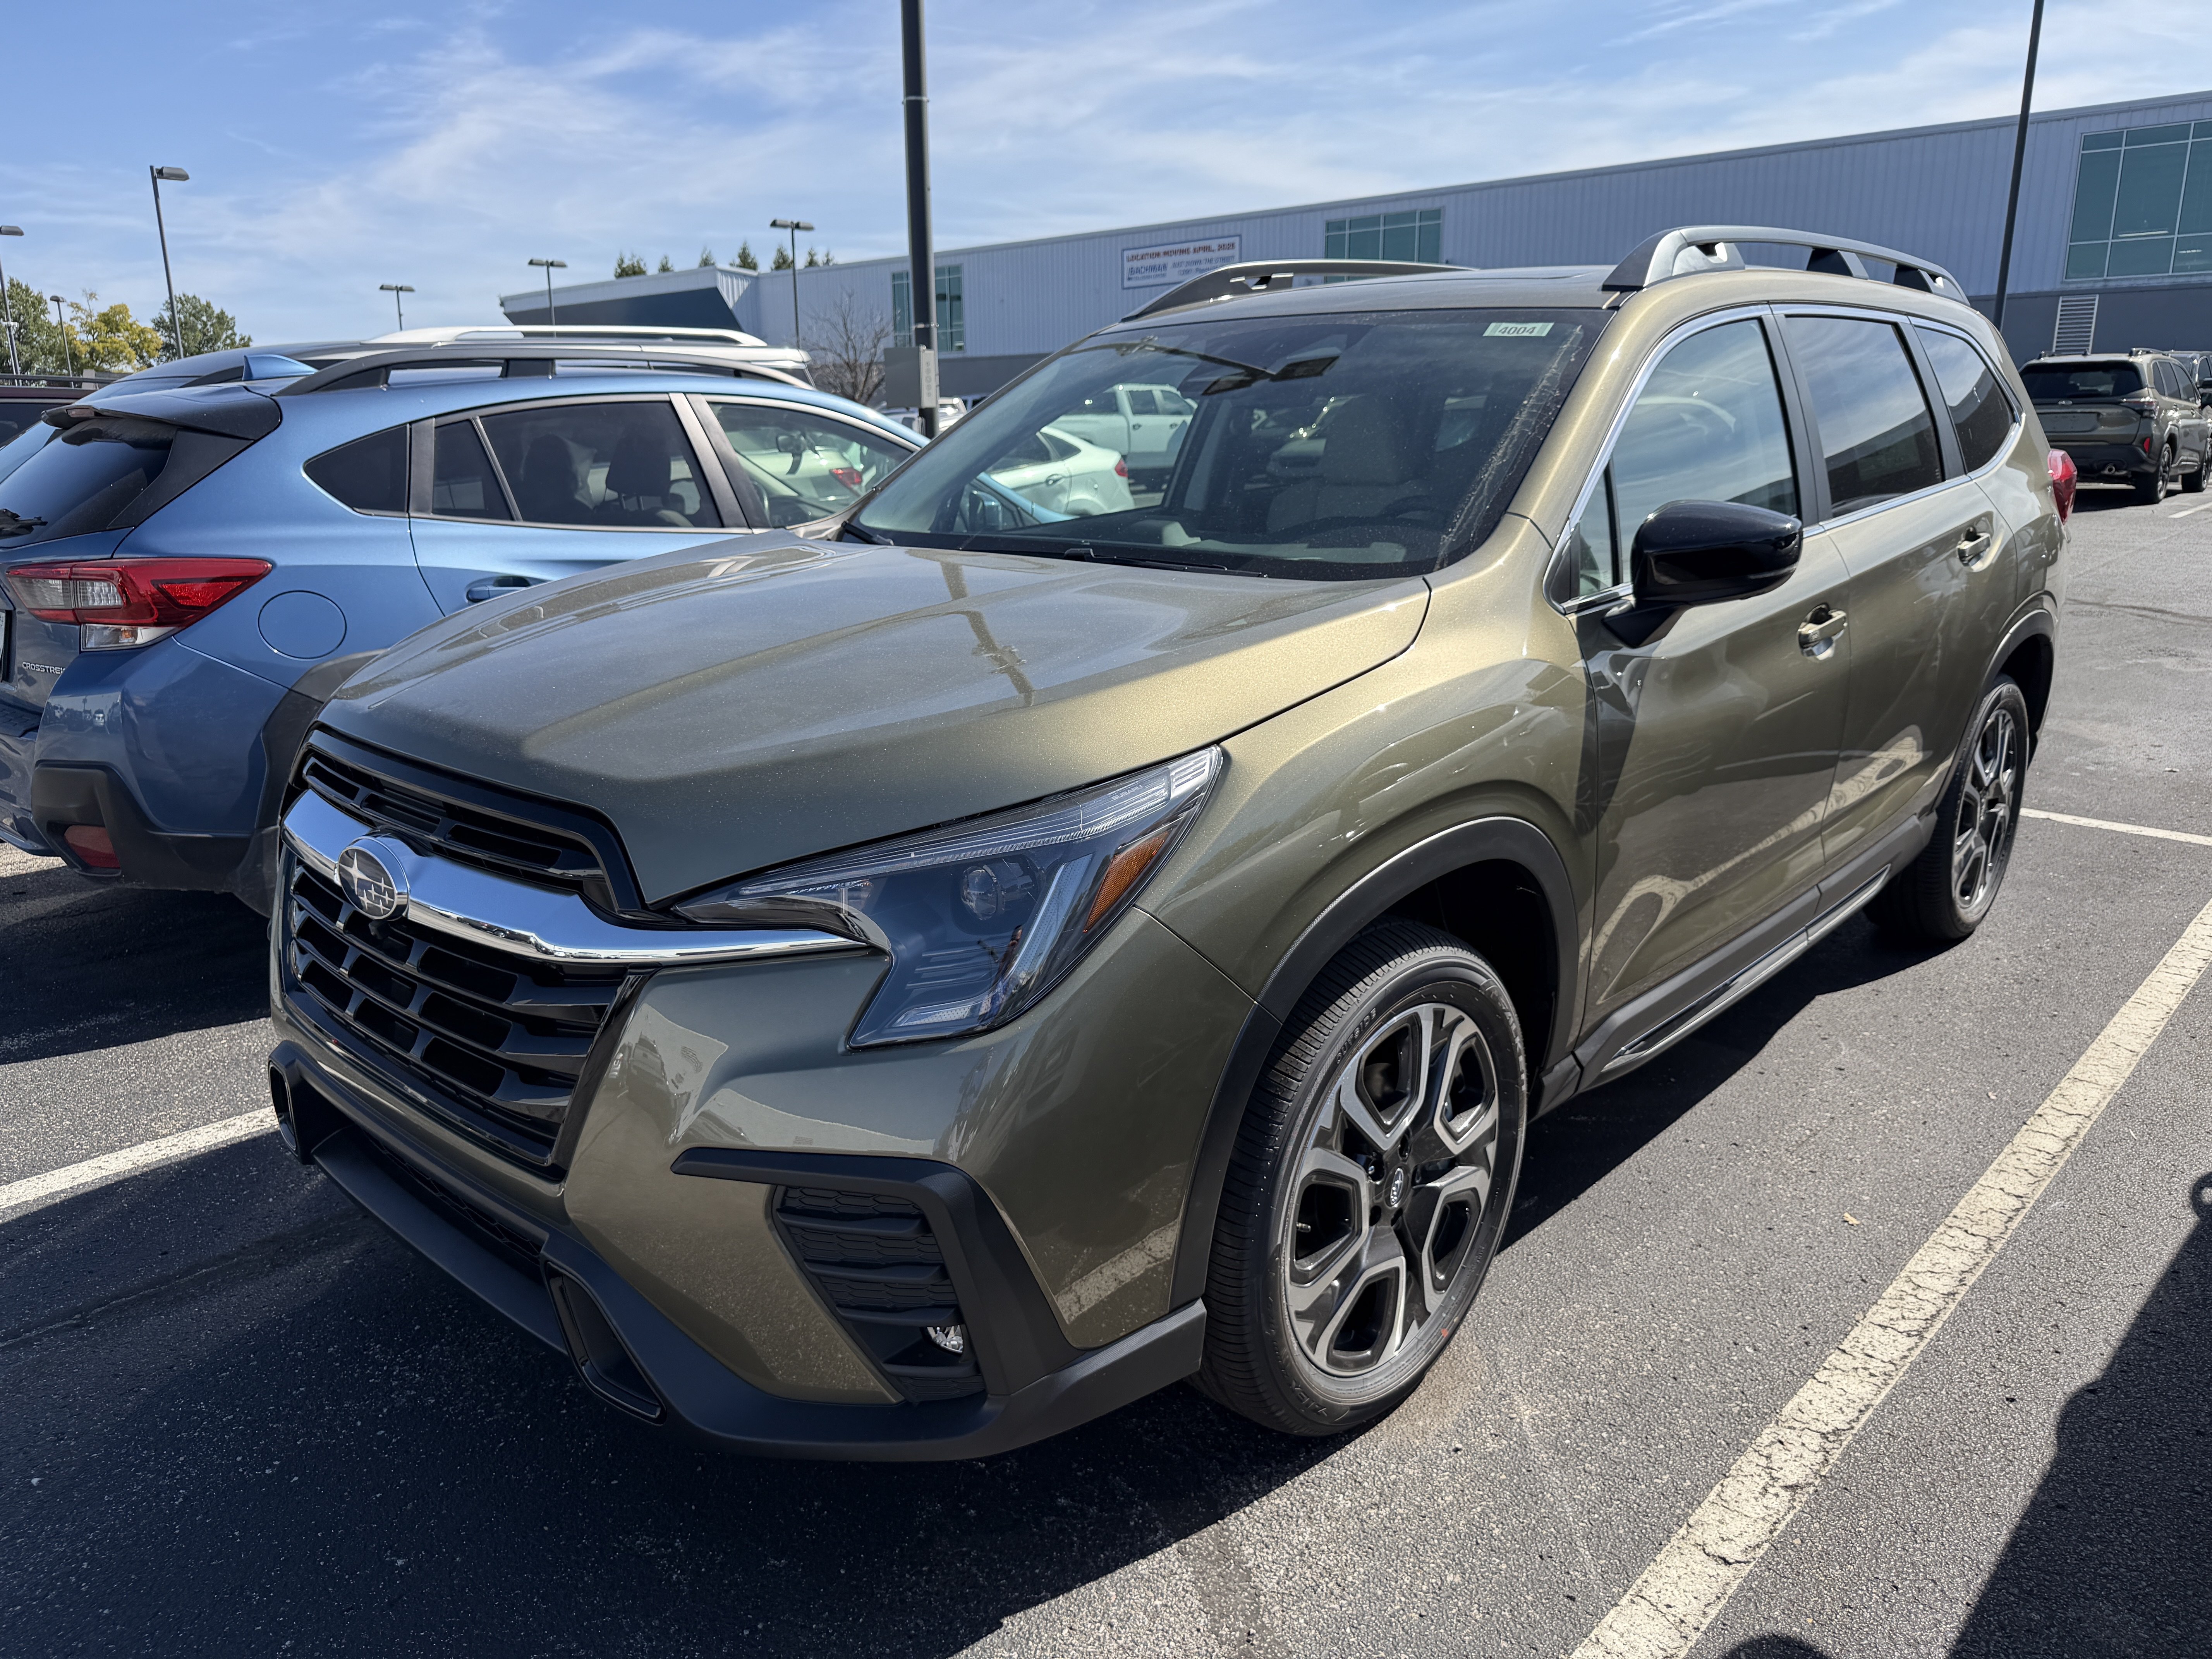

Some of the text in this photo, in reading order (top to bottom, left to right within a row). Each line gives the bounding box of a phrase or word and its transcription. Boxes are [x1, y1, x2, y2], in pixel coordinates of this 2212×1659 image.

[1163, 248, 1190, 257] MOVING
[1498, 326, 1536, 335] 4004
[1111, 785, 1143, 800] SUBARU
[1336, 1008, 1376, 1064] OUTSIDE
